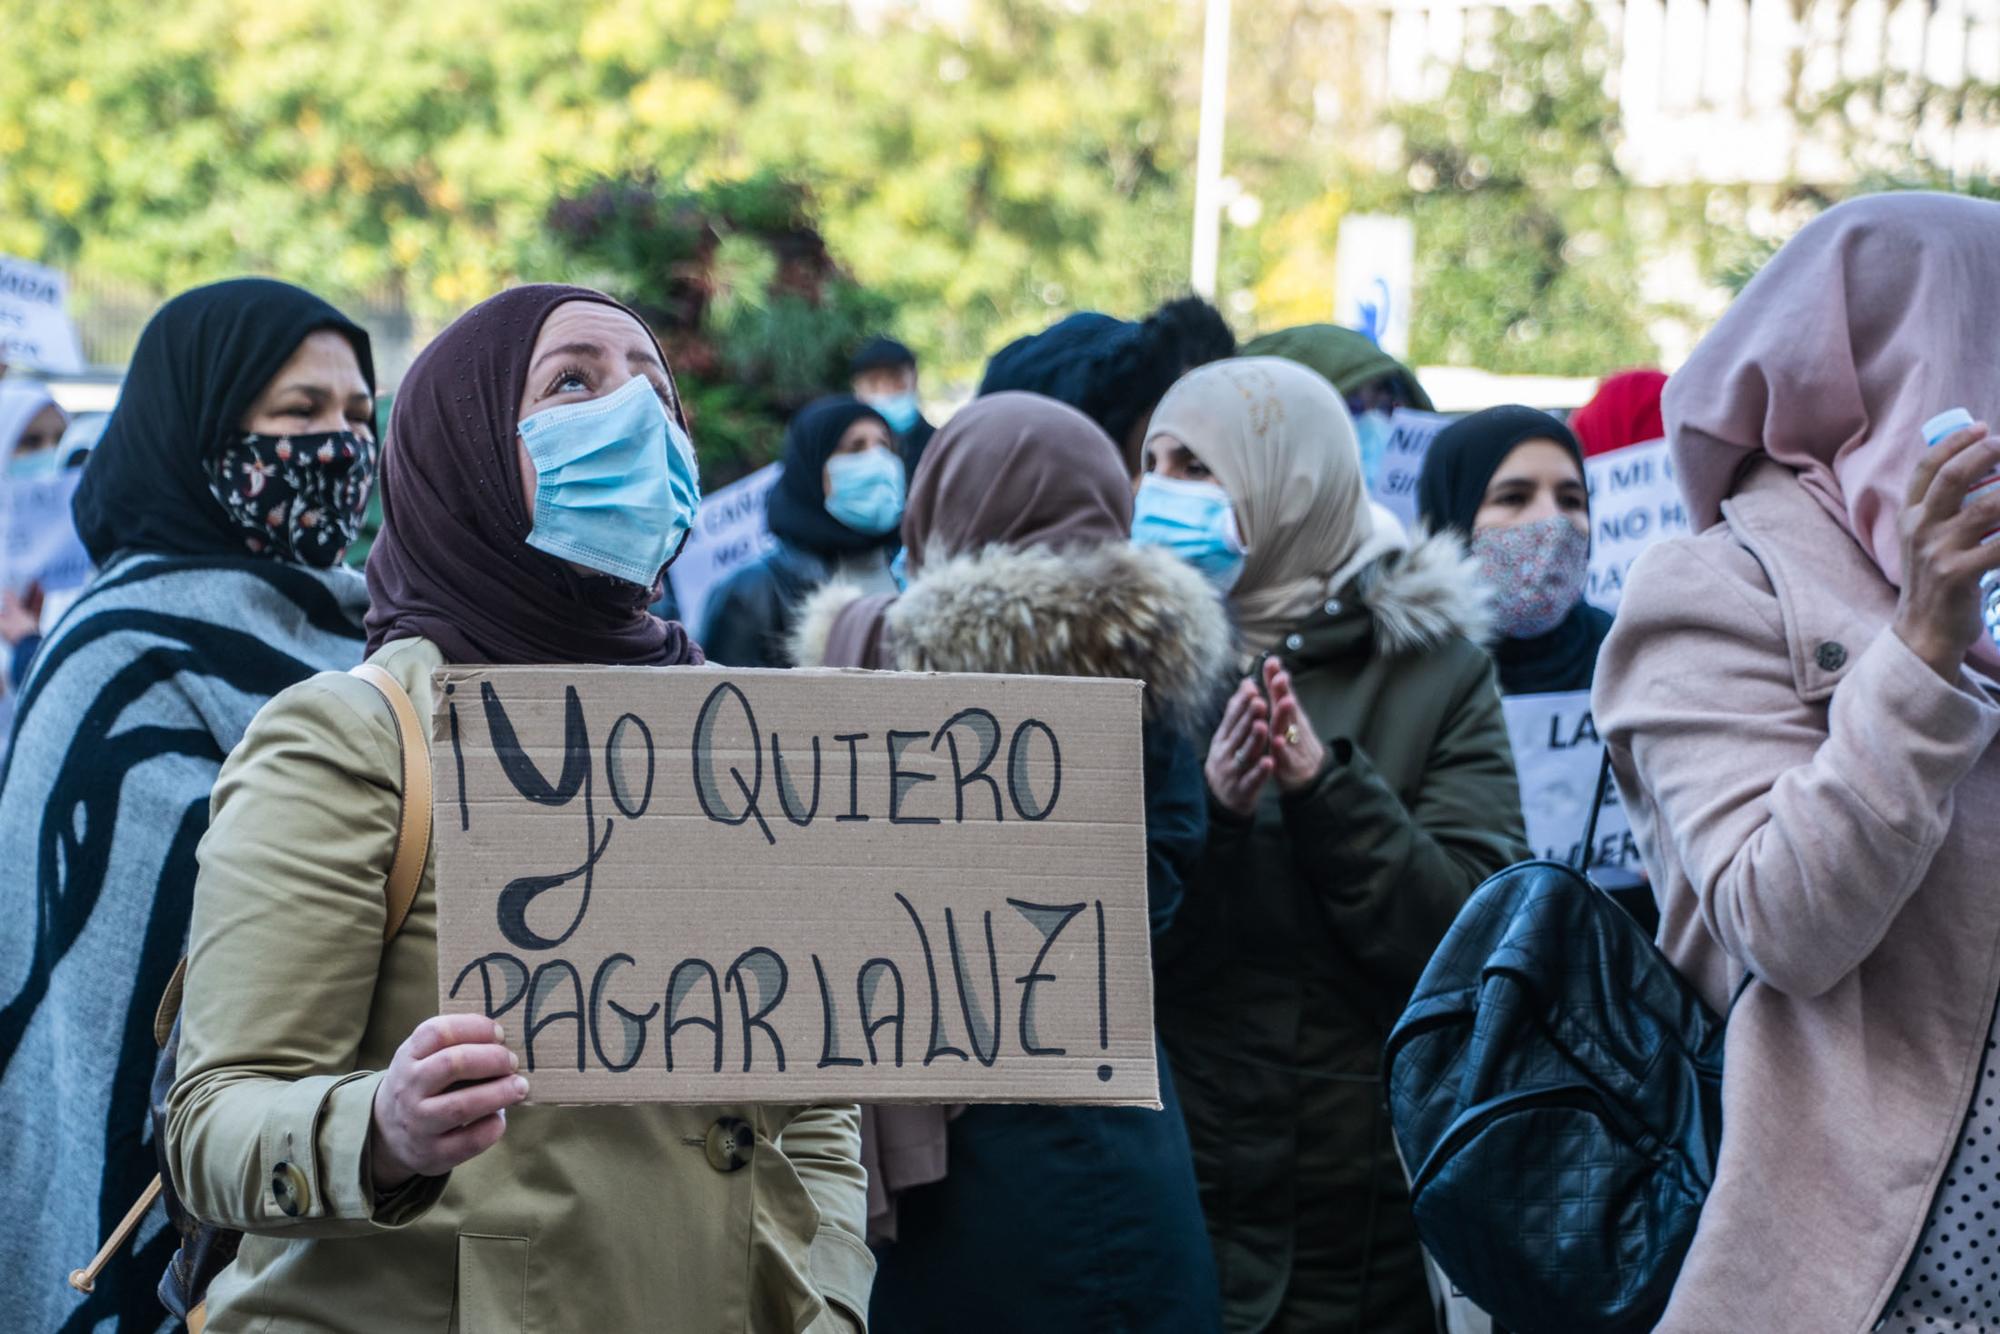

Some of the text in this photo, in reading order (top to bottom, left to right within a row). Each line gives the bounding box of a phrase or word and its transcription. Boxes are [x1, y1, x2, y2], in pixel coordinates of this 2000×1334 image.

[1600, 506, 1650, 544] NO
[692, 681, 1063, 844] QUIERO
[449, 946, 789, 1073] PAGAR
